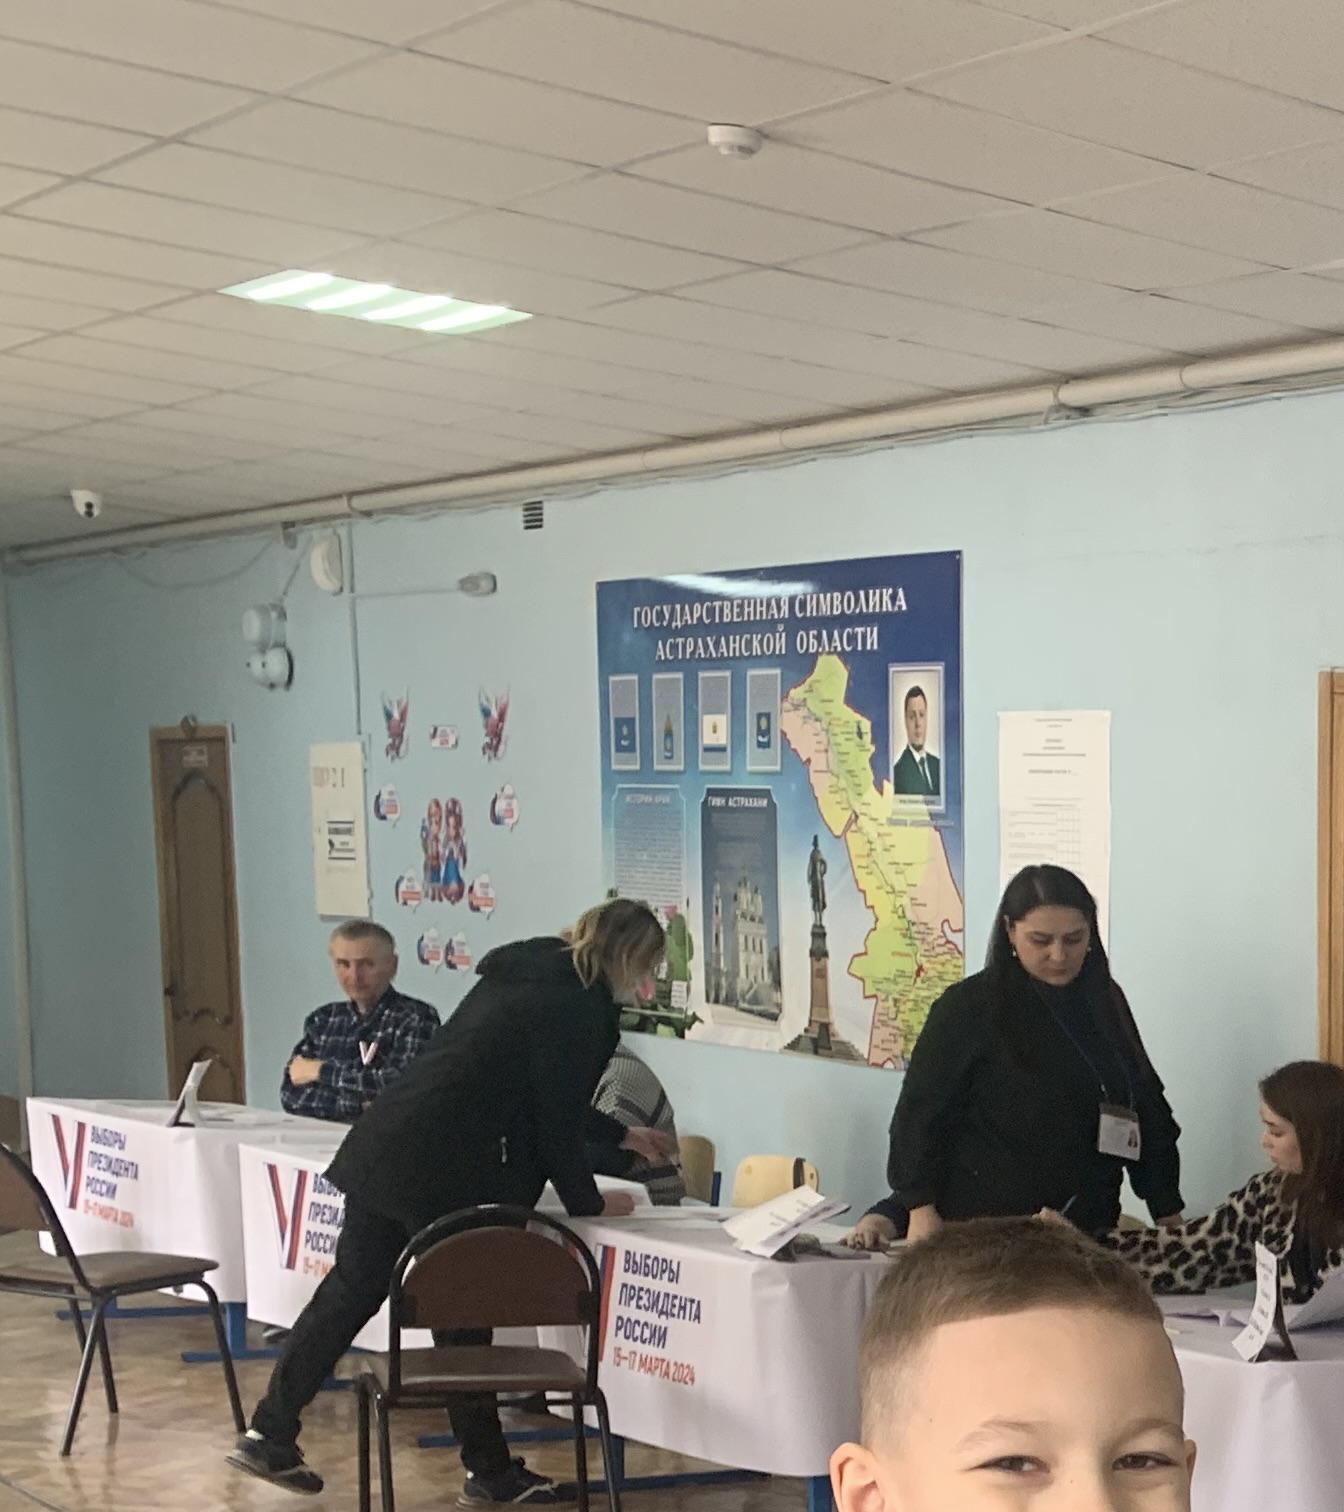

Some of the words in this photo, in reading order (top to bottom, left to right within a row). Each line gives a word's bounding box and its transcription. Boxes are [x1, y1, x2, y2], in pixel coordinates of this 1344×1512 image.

[633, 594, 789, 629] ГОСУДАРСТВЕННАЯ
[794, 587, 908, 617] СИМВОЛИКА
[655, 624, 787, 661] АСТРАХАНСКОЙ
[796, 626, 879, 653] ОБЛАСТИ
[728, 796, 768, 808] АСТРАХАНИ
[307, 1201, 346, 1230] ПРЕЗИД
[304, 1229, 338, 1256] РОССИ
[623, 1248, 681, 1285] ВЫБОРЫ
[618, 1282, 702, 1325] ПРЕЗИДЕНТА
[614, 1314, 668, 1350] РОССИИ
[637, 1354, 671, 1381] МАРТА
[671, 1361, 697, 1387] 2024
